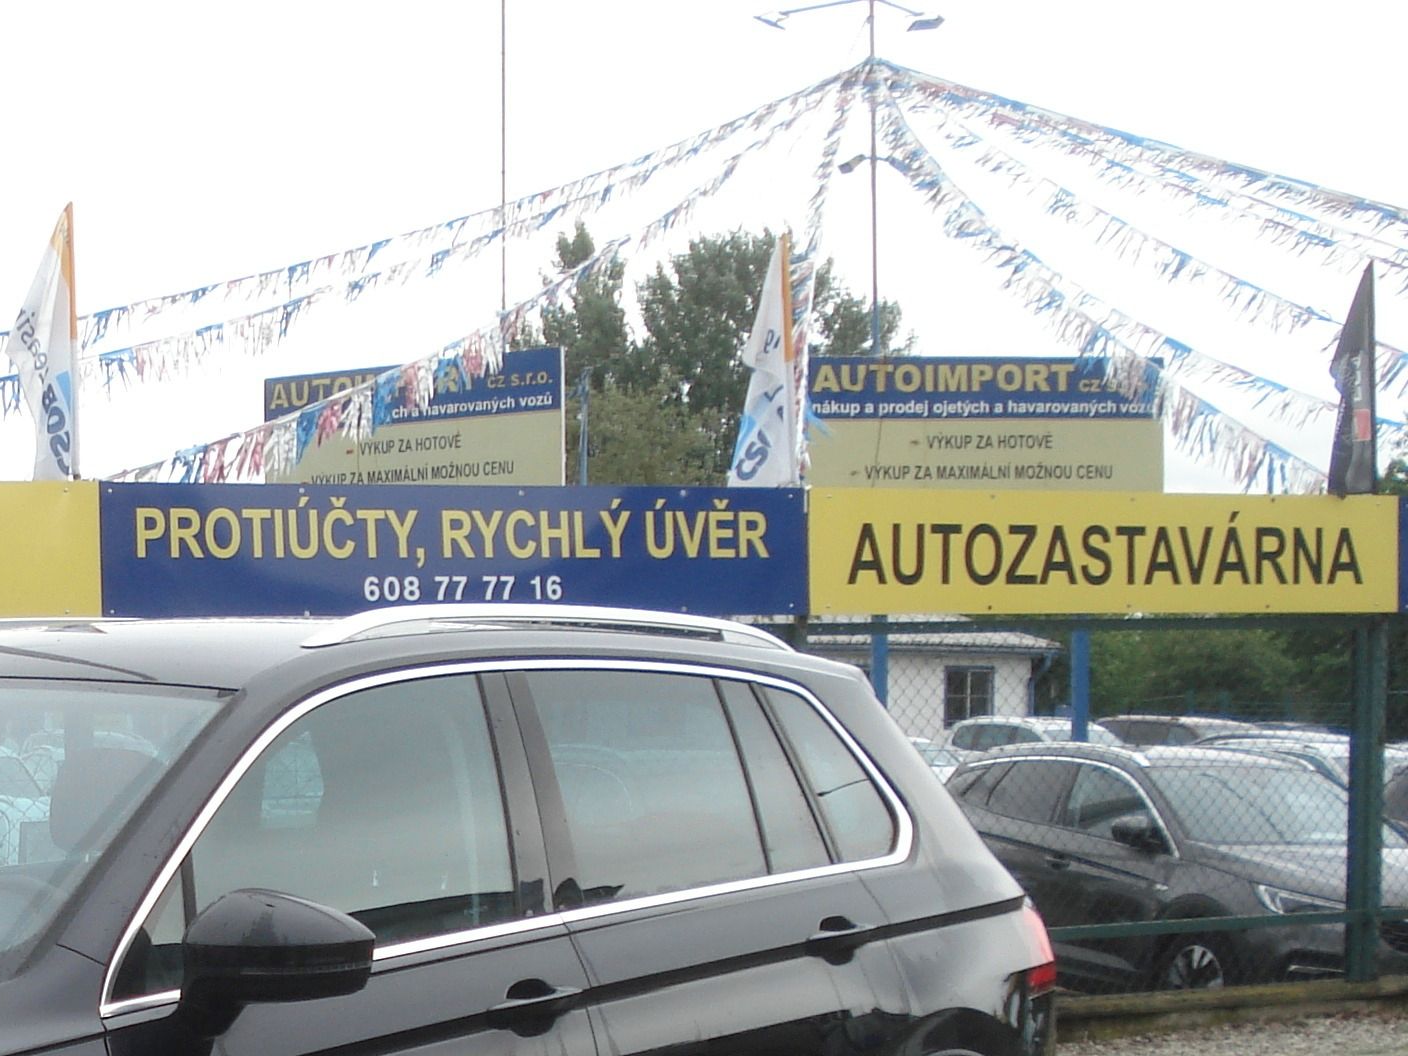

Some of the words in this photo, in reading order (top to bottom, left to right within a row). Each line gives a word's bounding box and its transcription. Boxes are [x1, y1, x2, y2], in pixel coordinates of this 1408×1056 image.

[487, 377, 506, 389] cz
[511, 371, 553, 386] s.r.o.
[812, 363, 1076, 393] AUTOIMPORT
[1079, 379, 1101, 392] cz
[519, 392, 553, 407] vozů
[812, 400, 860, 416] nákup
[865, 403, 874, 413] a
[879, 400, 929, 417] prodej
[933, 400, 989, 417] ojetých
[994, 403, 1003, 413] a
[1008, 400, 1116, 417] havarovaných
[360, 440, 395, 456] VÝKUP
[398, 439, 413, 453] ZA
[416, 432, 462, 451] HOTOVÉ
[927, 432, 973, 449] VÝKUP
[976, 435, 993, 449] ZA
[997, 432, 1054, 449] HOTOVÉ
[349, 472, 364, 485] ZA
[368, 464, 429, 484] MAXIMÁLNÍ
[431, 462, 480, 480] MOŽNOU
[483, 460, 515, 475] CENU
[865, 462, 911, 480] VÝKUP
[914, 466, 933, 480] ZA
[936, 461, 1011, 480] MAXIMÁLNÍ
[1014, 462, 1072, 480] MOŽNOU
[1076, 464, 1113, 479] CENU
[136, 496, 426, 568] PROTIÚČTY,
[442, 498, 631, 559] RYCHLÝ
[645, 498, 770, 559] ÚVĚR
[846, 511, 1364, 585] AUTOZASTAVÁRNA
[363, 576, 420, 601] 608
[434, 575, 468, 601] 77
[482, 575, 515, 600] 77
[530, 575, 562, 600] 16
